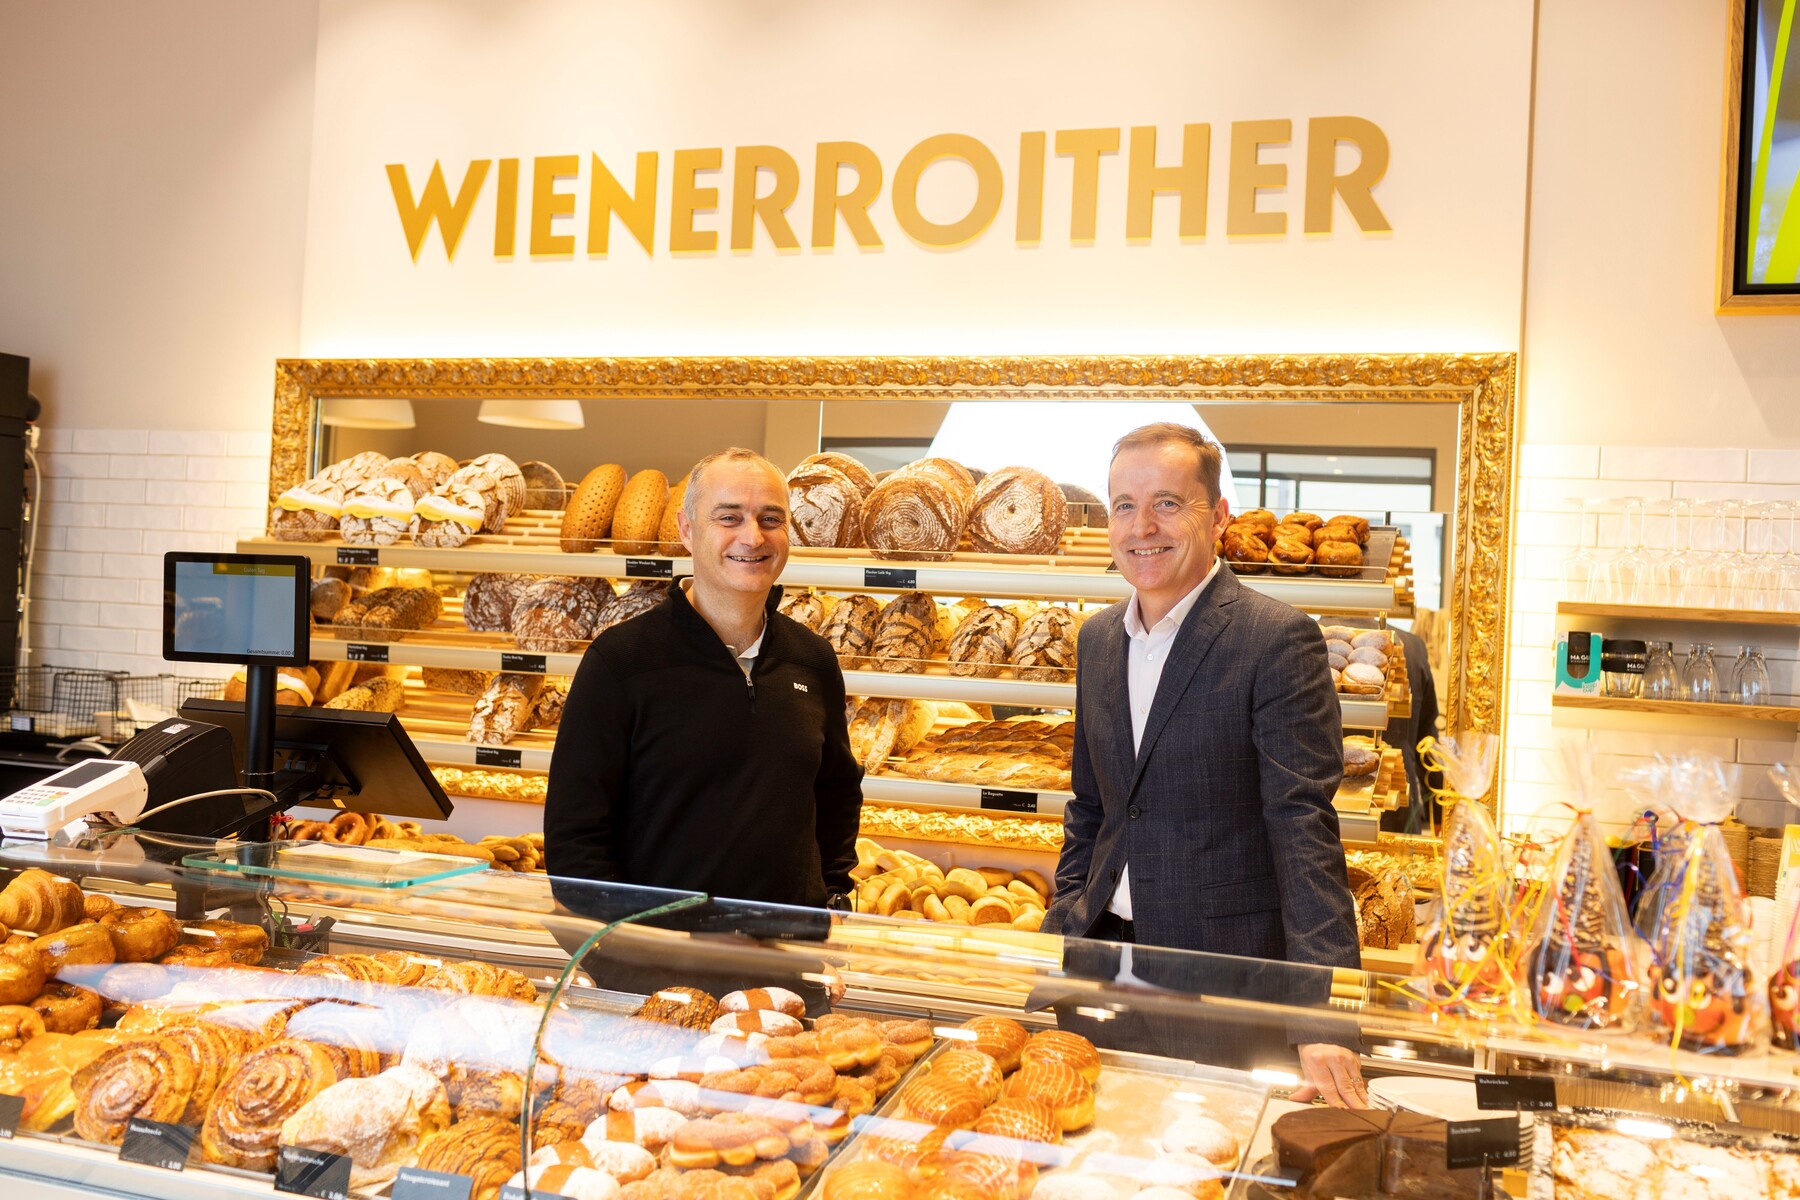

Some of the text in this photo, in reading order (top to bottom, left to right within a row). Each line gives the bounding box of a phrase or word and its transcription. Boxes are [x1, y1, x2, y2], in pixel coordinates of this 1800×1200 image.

[385, 115, 1394, 263] WIENERROITHER
[793, 682, 808, 692] BOSS
[400, 1172, 450, 1189] Nougatcroissant
